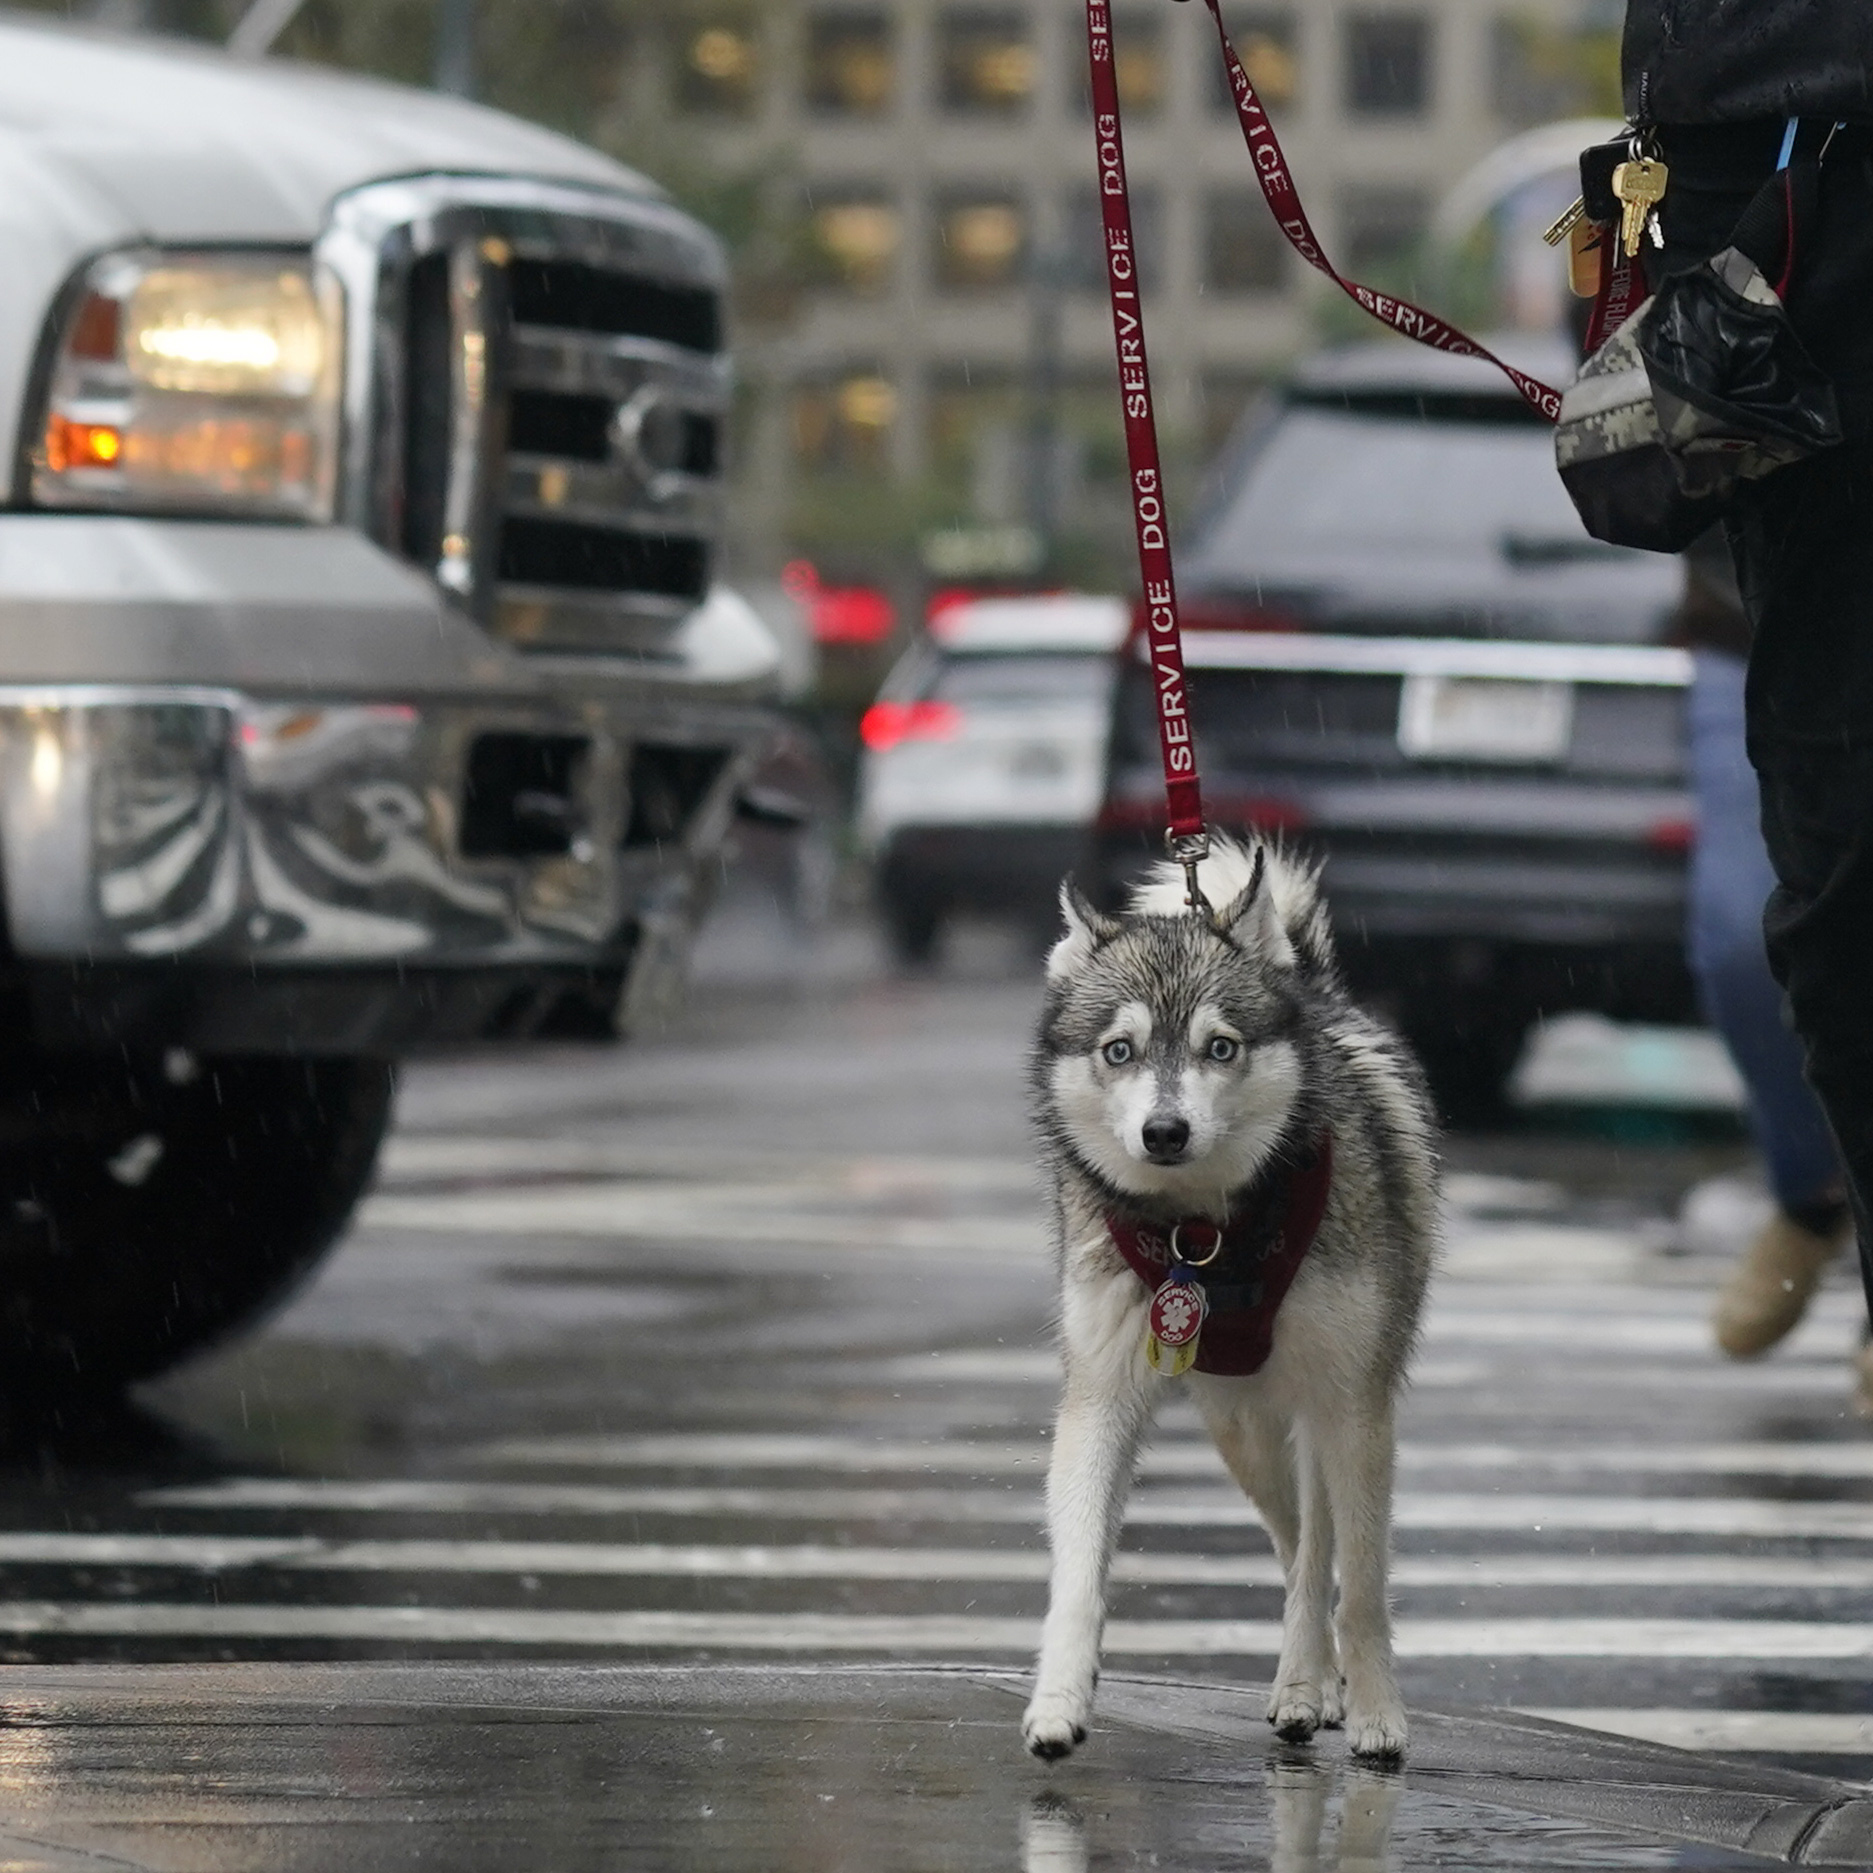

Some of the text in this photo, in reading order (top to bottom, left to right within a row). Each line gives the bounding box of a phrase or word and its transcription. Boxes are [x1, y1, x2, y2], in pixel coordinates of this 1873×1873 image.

[1098, 113, 1123, 196] DOG
[1108, 227, 1148, 418] SERVICE
[1135, 468, 1165, 550] DOG
[1149, 578, 1193, 771] SERVICE
[1157, 1287, 1199, 1312] SERVICE
[1160, 1330, 1184, 1342] DOG
